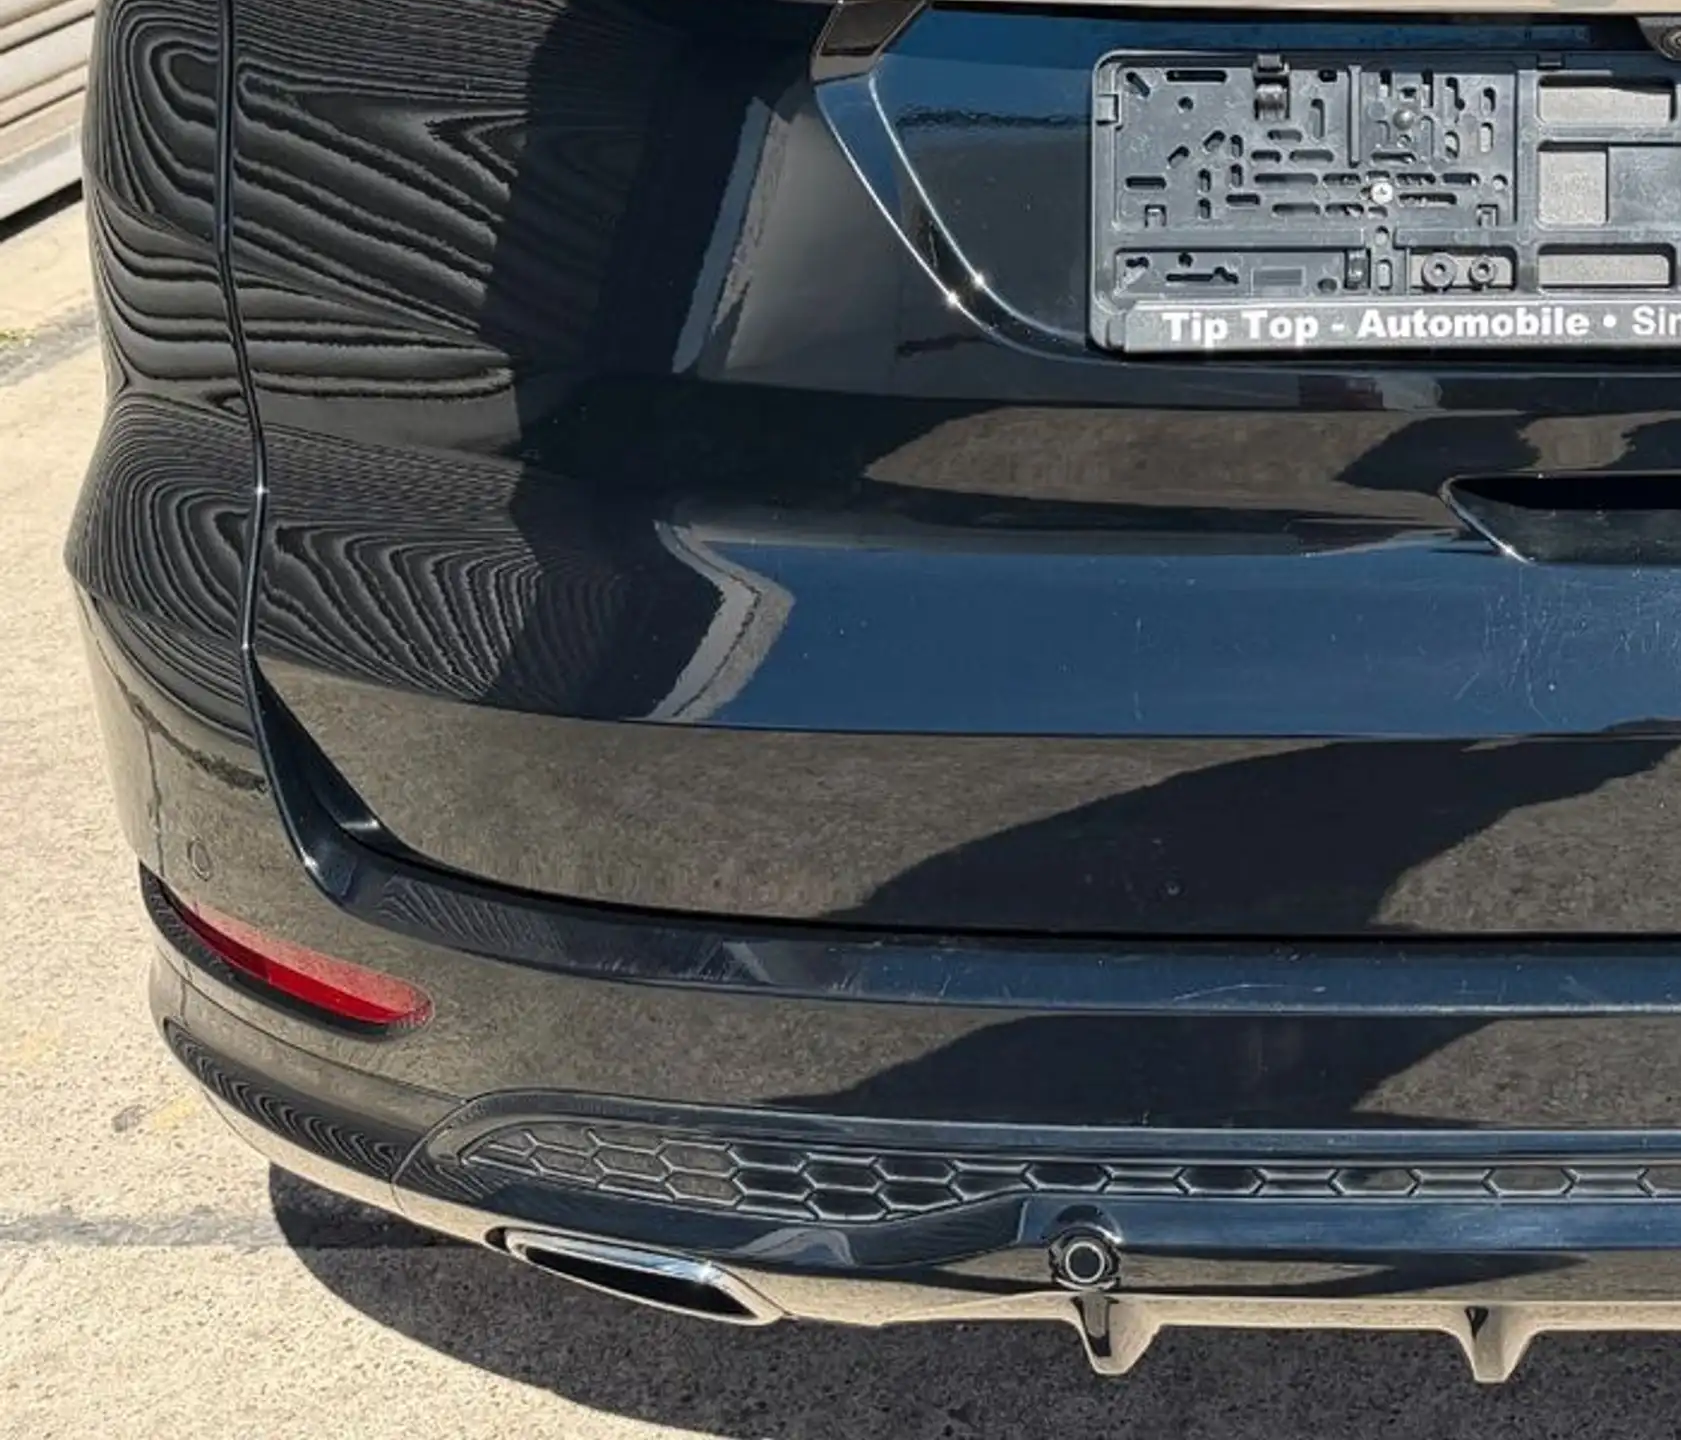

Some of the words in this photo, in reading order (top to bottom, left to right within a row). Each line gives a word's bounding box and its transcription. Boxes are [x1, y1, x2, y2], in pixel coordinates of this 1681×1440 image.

[1162, 311, 1228, 348] Tip
[1241, 310, 1319, 346] Top
[1357, 307, 1590, 338] Automobile
